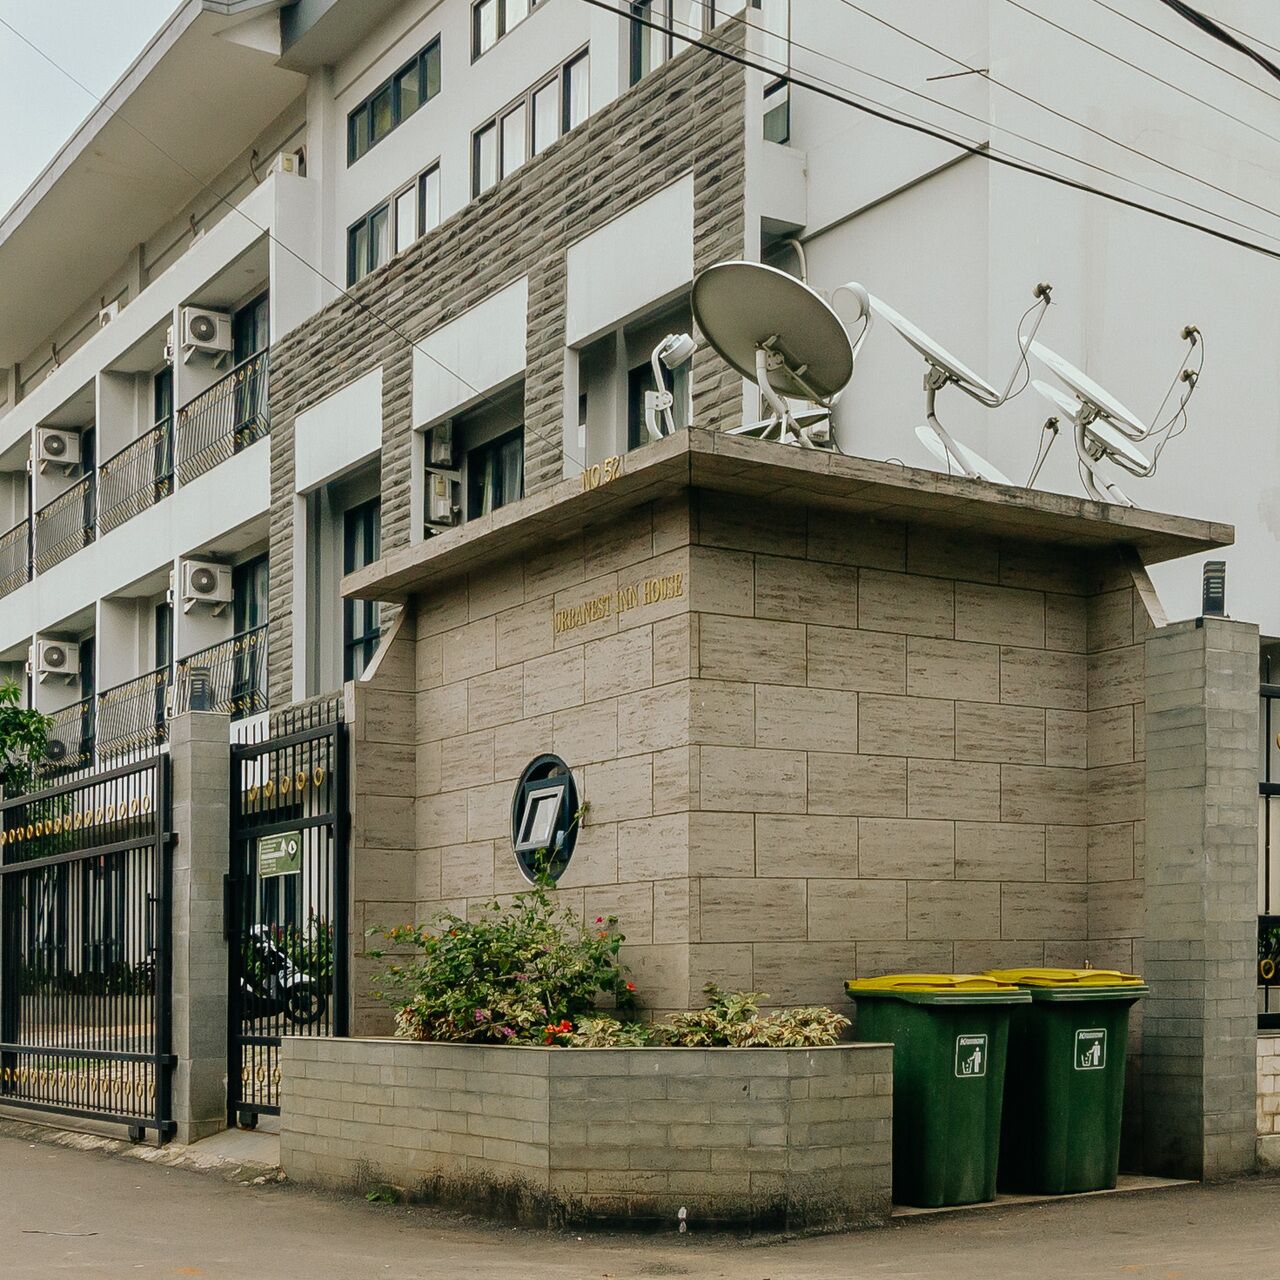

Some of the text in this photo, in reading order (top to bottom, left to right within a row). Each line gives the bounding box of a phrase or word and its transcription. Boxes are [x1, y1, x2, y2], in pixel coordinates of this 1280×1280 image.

[581, 455, 621, 490] NO 52
[555, 571, 683, 633] URBANEST INN HOUSE
